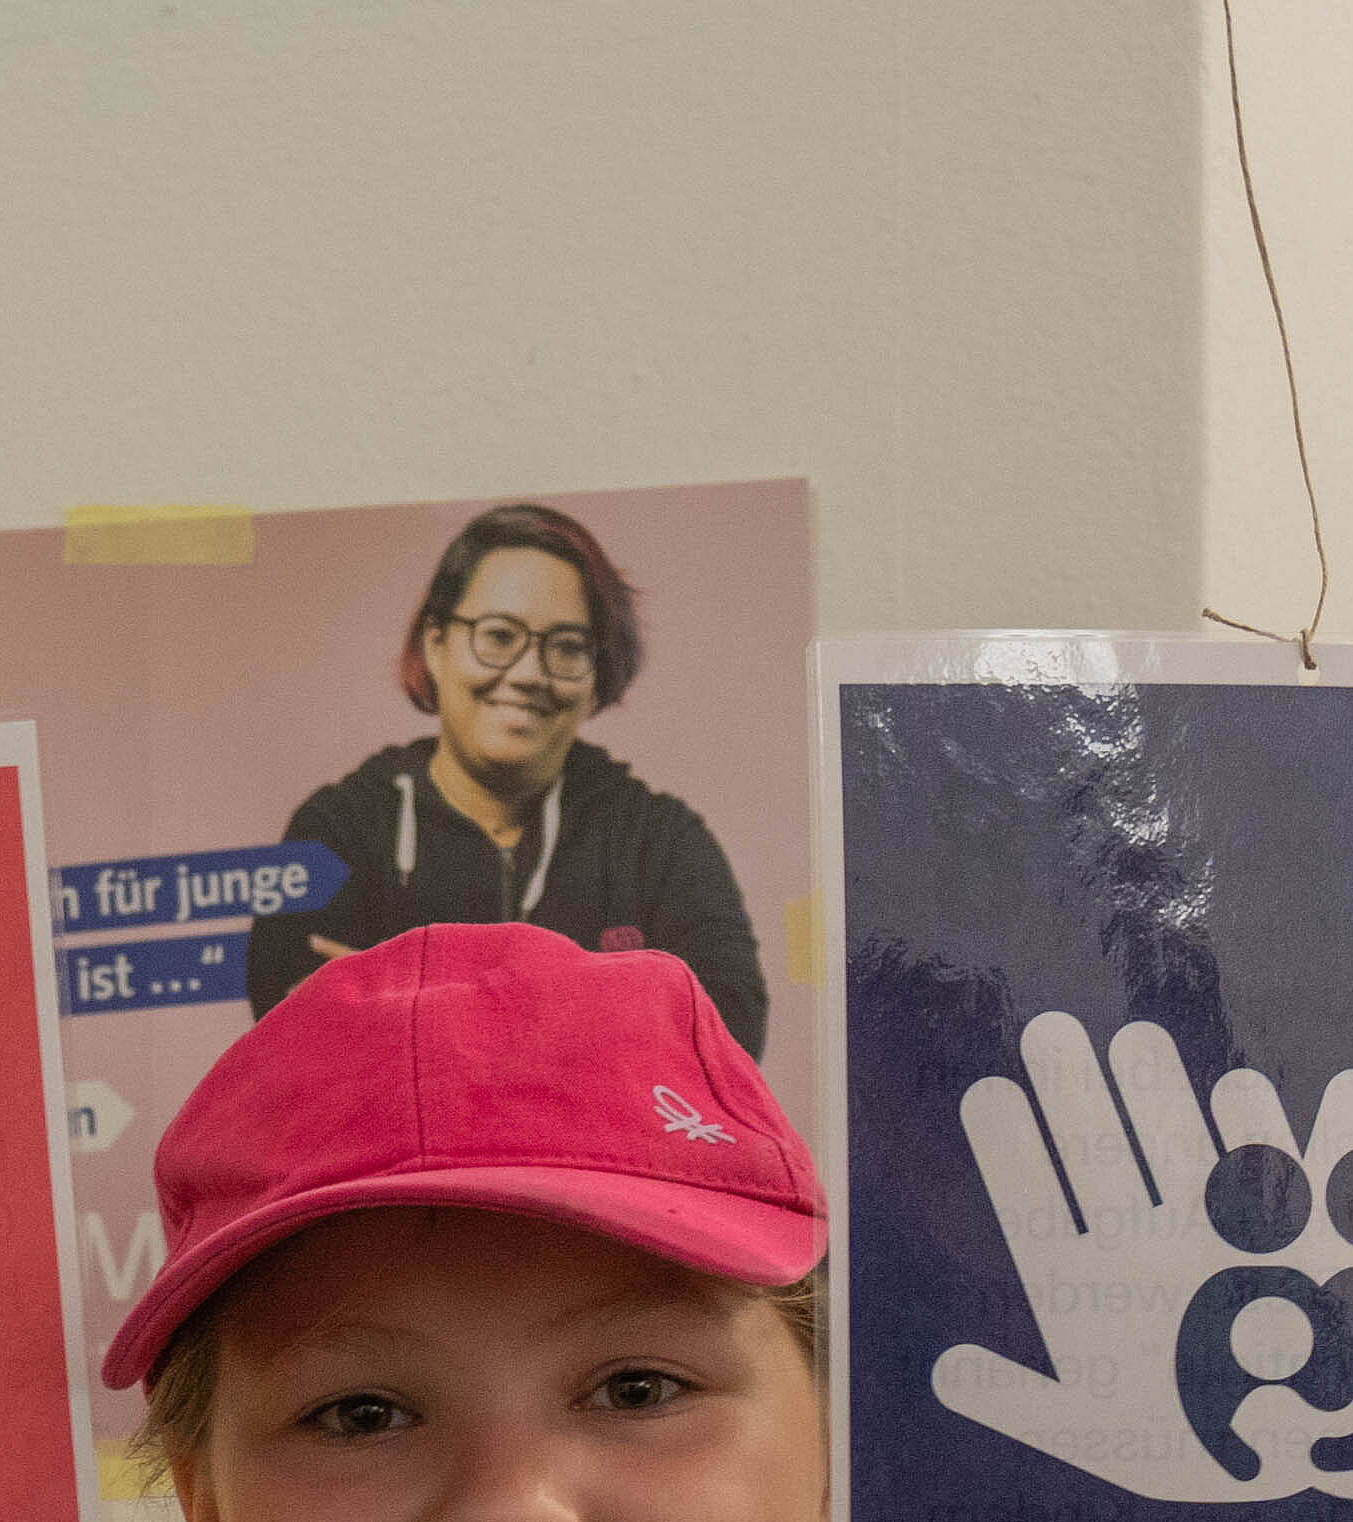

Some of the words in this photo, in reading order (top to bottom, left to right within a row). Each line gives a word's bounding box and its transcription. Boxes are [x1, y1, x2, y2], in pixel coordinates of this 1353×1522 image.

[95, 868, 162, 917] für
[176, 863, 310, 922] junge
[77, 953, 135, 1001] ist
